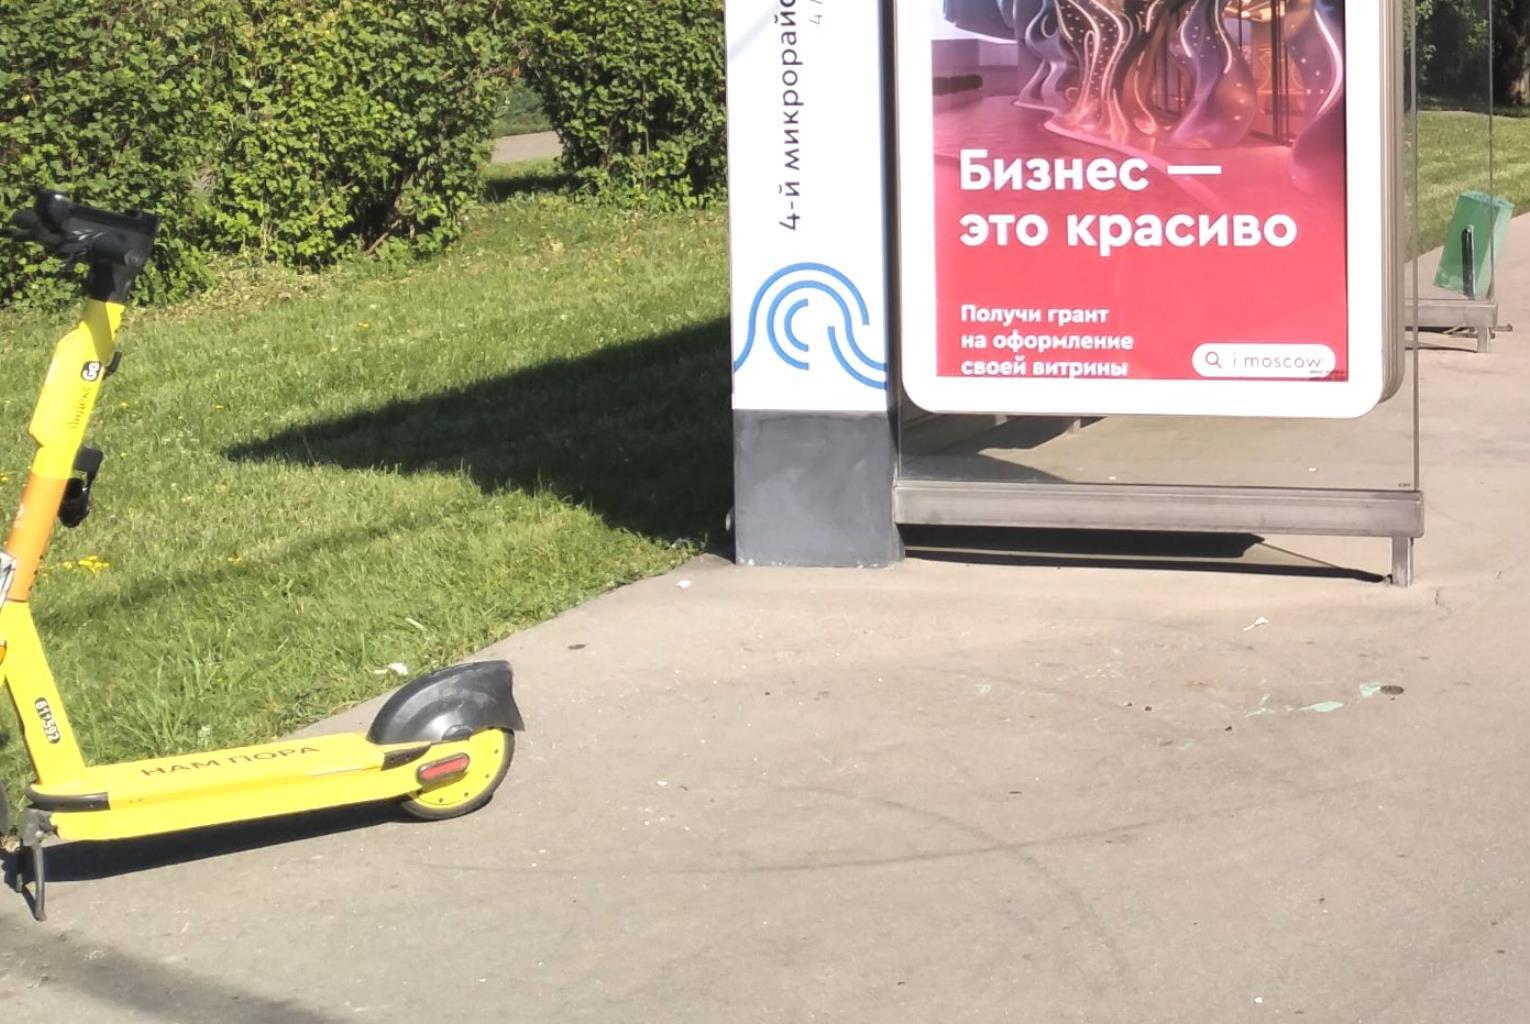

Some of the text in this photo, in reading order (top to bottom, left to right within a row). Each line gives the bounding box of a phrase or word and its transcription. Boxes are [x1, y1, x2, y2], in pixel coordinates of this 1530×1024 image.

[808, 14, 823, 25] 4
[959, 148, 1149, 191] Бизнес
[778, 181, 801, 231] 4-й
[959, 213, 1298, 257] это красиво
[961, 304, 1109, 327] Получи грант
[961, 330, 1134, 354] на оформление
[82, 361, 101, 381] Go
[961, 355, 1128, 379] своей витрины
[141, 746, 320, 776] НАМ ПОРА
